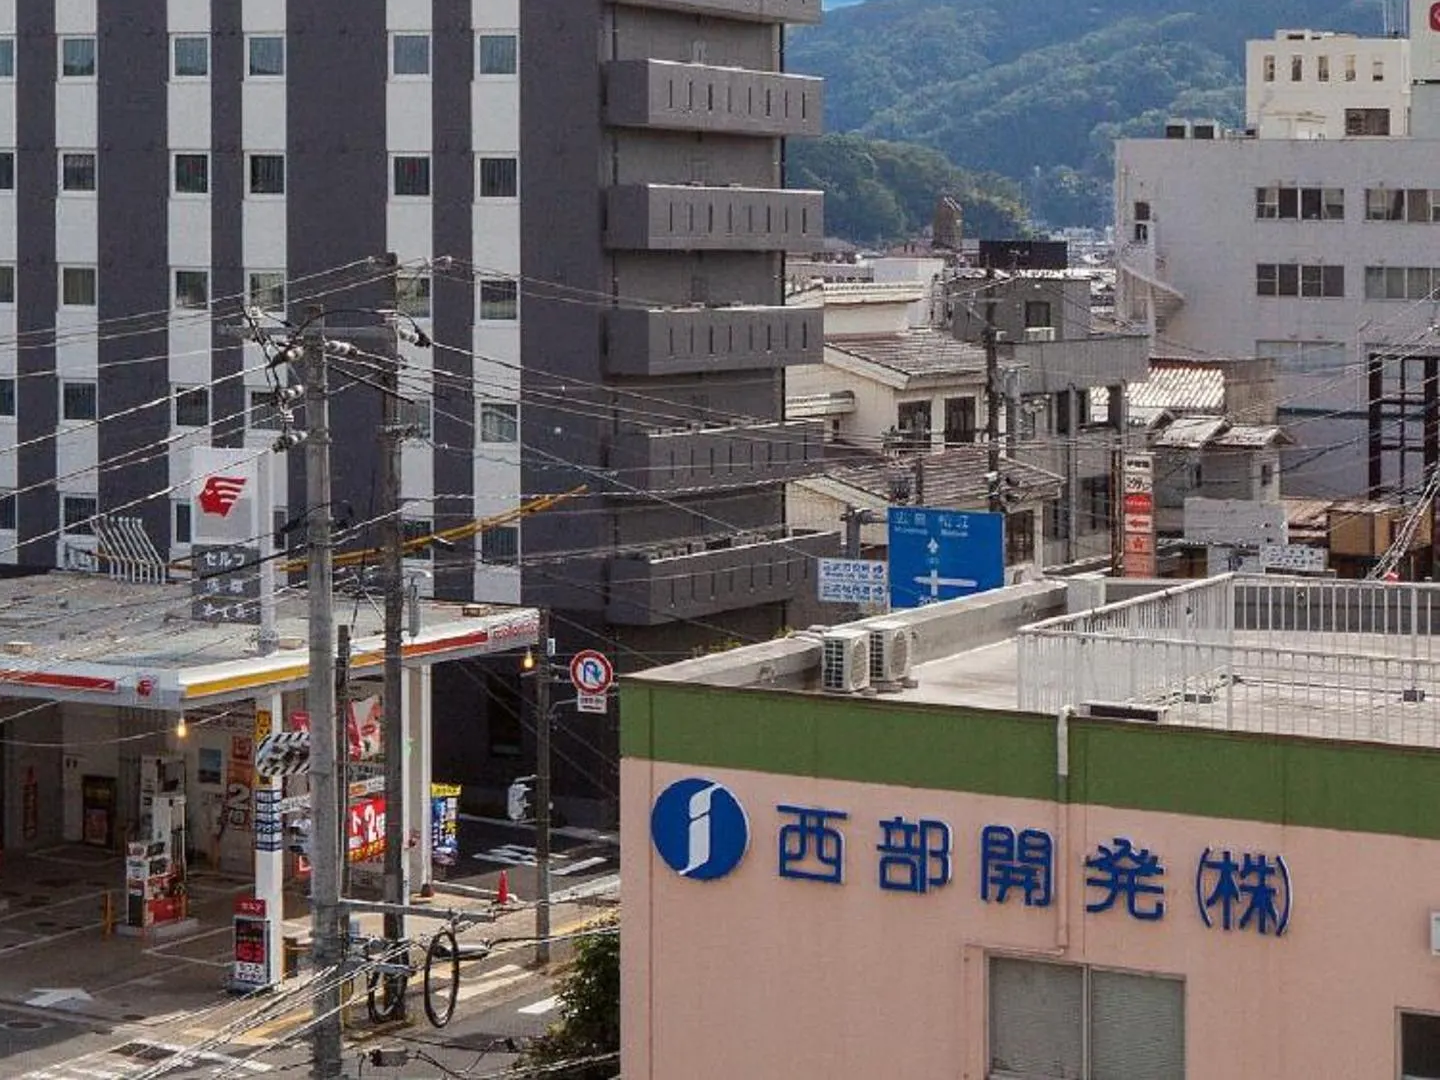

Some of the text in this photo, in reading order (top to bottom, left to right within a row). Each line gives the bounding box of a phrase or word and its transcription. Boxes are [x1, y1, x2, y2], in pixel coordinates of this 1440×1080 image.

[205, 551, 245, 567] セルフ
[776, 804, 1295, 937] 西部開発(株)
